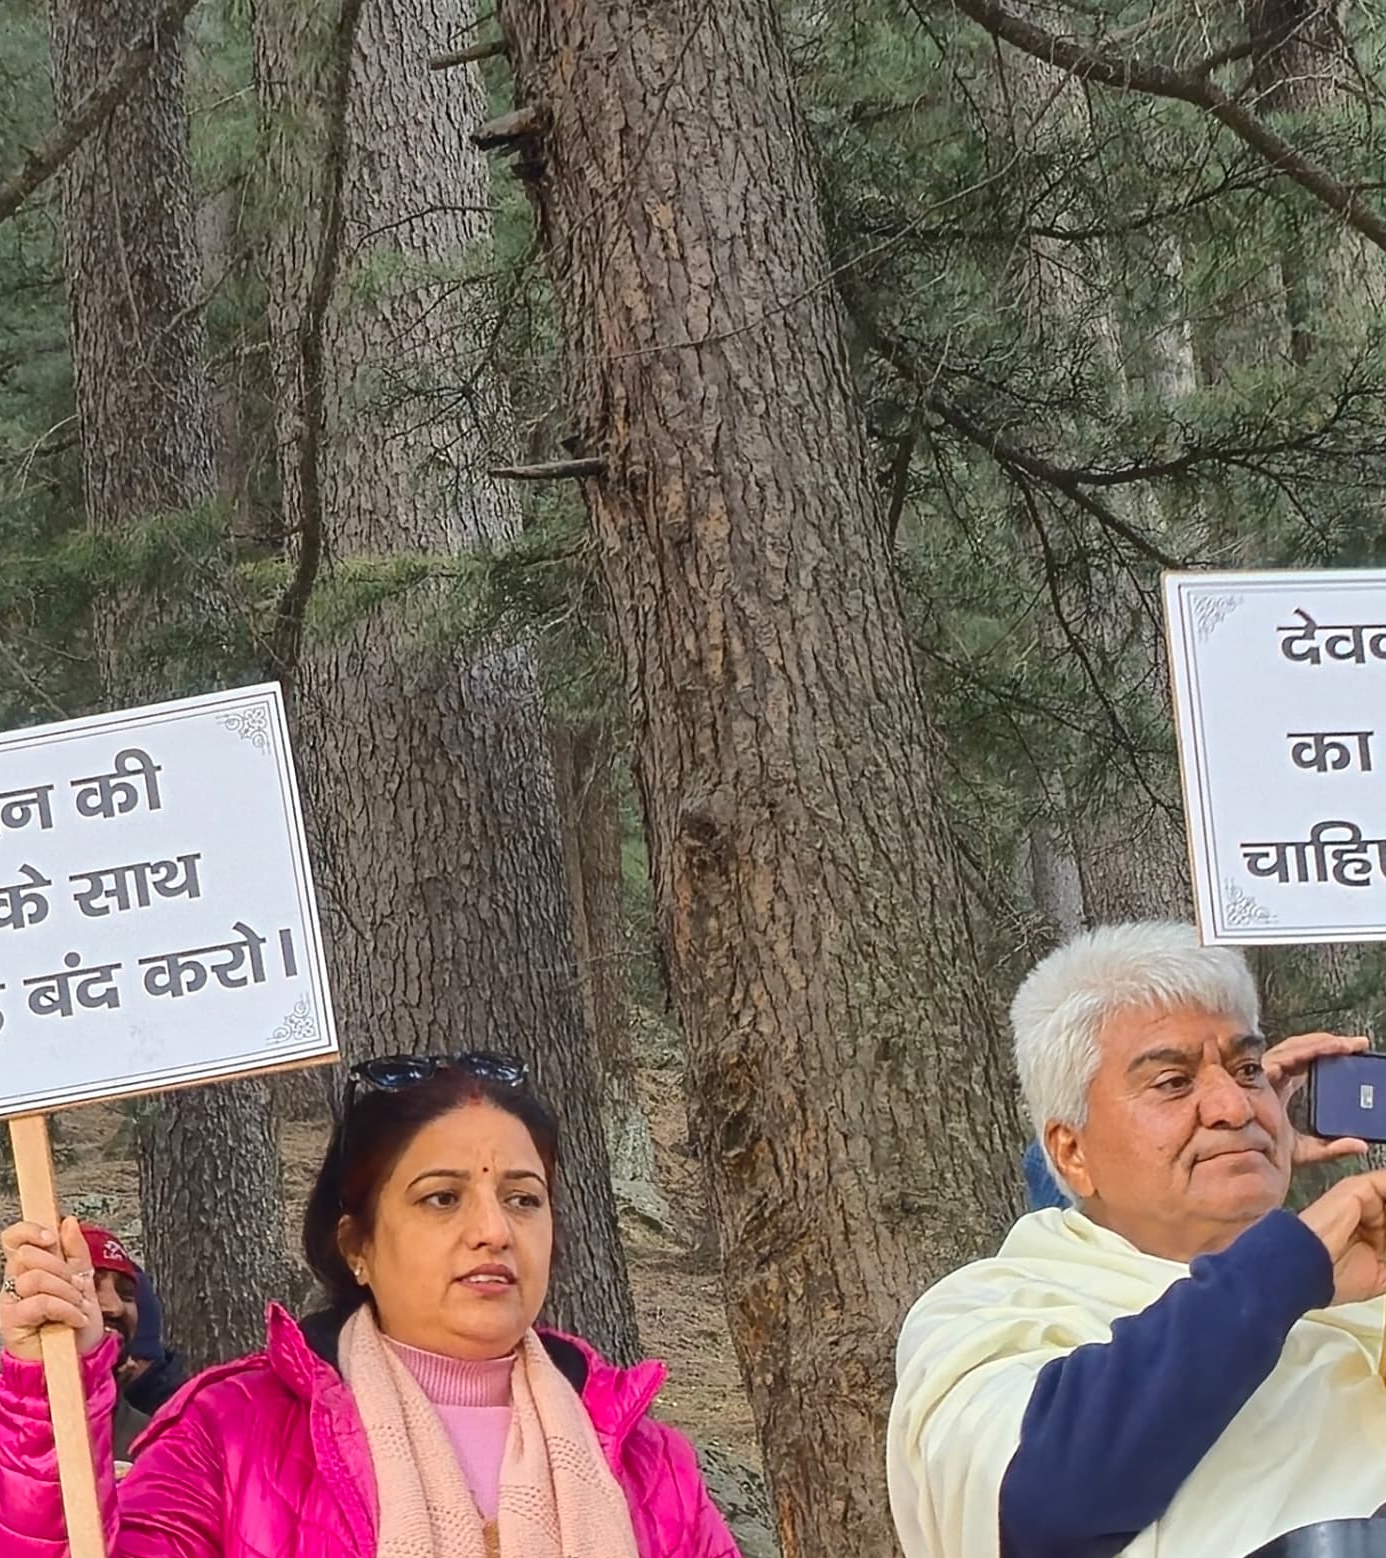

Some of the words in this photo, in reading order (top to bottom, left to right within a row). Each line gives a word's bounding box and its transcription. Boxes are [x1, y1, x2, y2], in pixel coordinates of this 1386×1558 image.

[70, 748, 162, 818] की
[1286, 731, 1374, 773] का
[69, 853, 201, 917] साथ
[23, 953, 122, 1018] बंद
